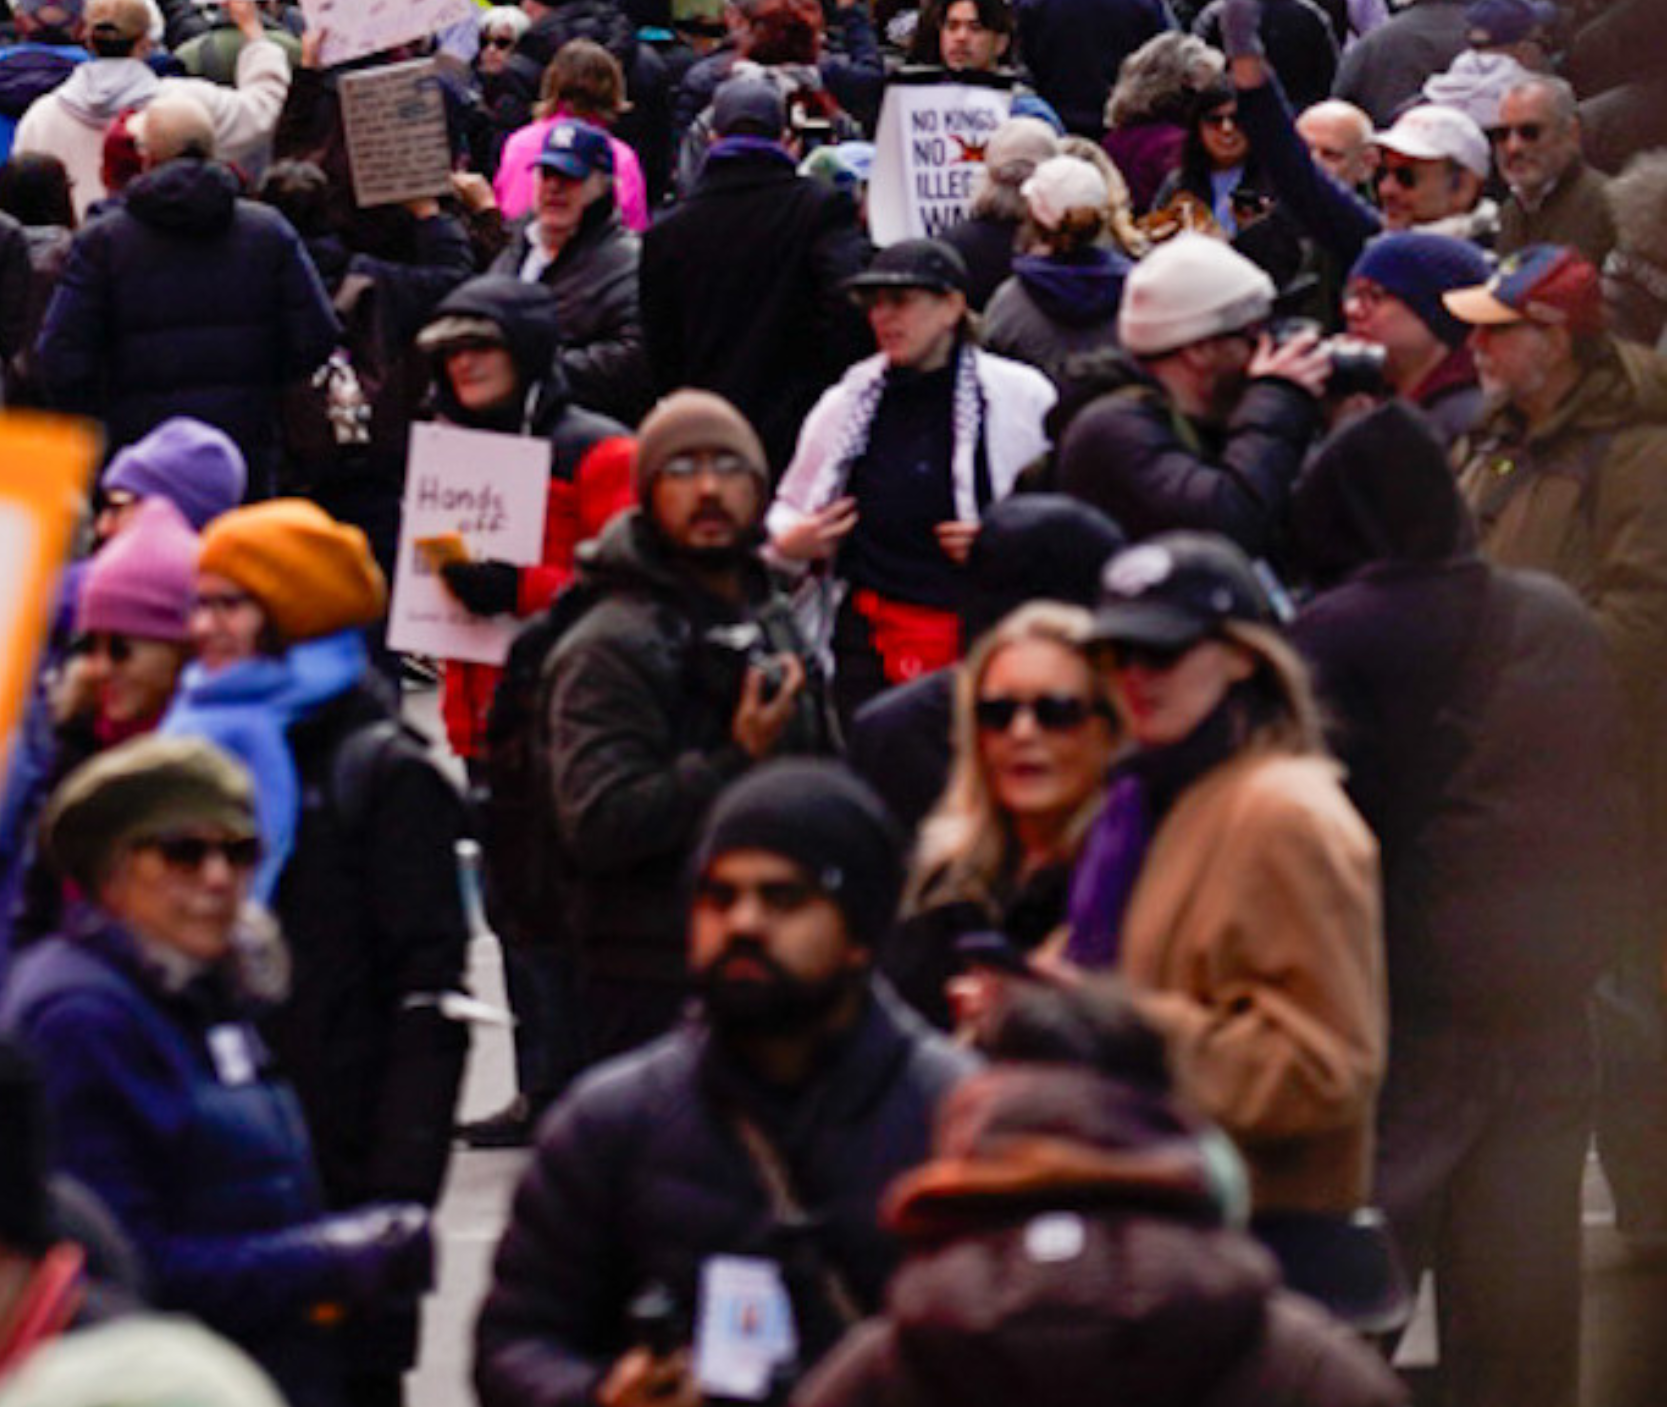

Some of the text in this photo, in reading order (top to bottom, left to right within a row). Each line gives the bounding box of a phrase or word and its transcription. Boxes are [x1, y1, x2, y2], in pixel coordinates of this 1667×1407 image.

[911, 108, 998, 132] NO KINGS
[913, 138, 946, 168] NO
[419, 475, 507, 518] Hands
